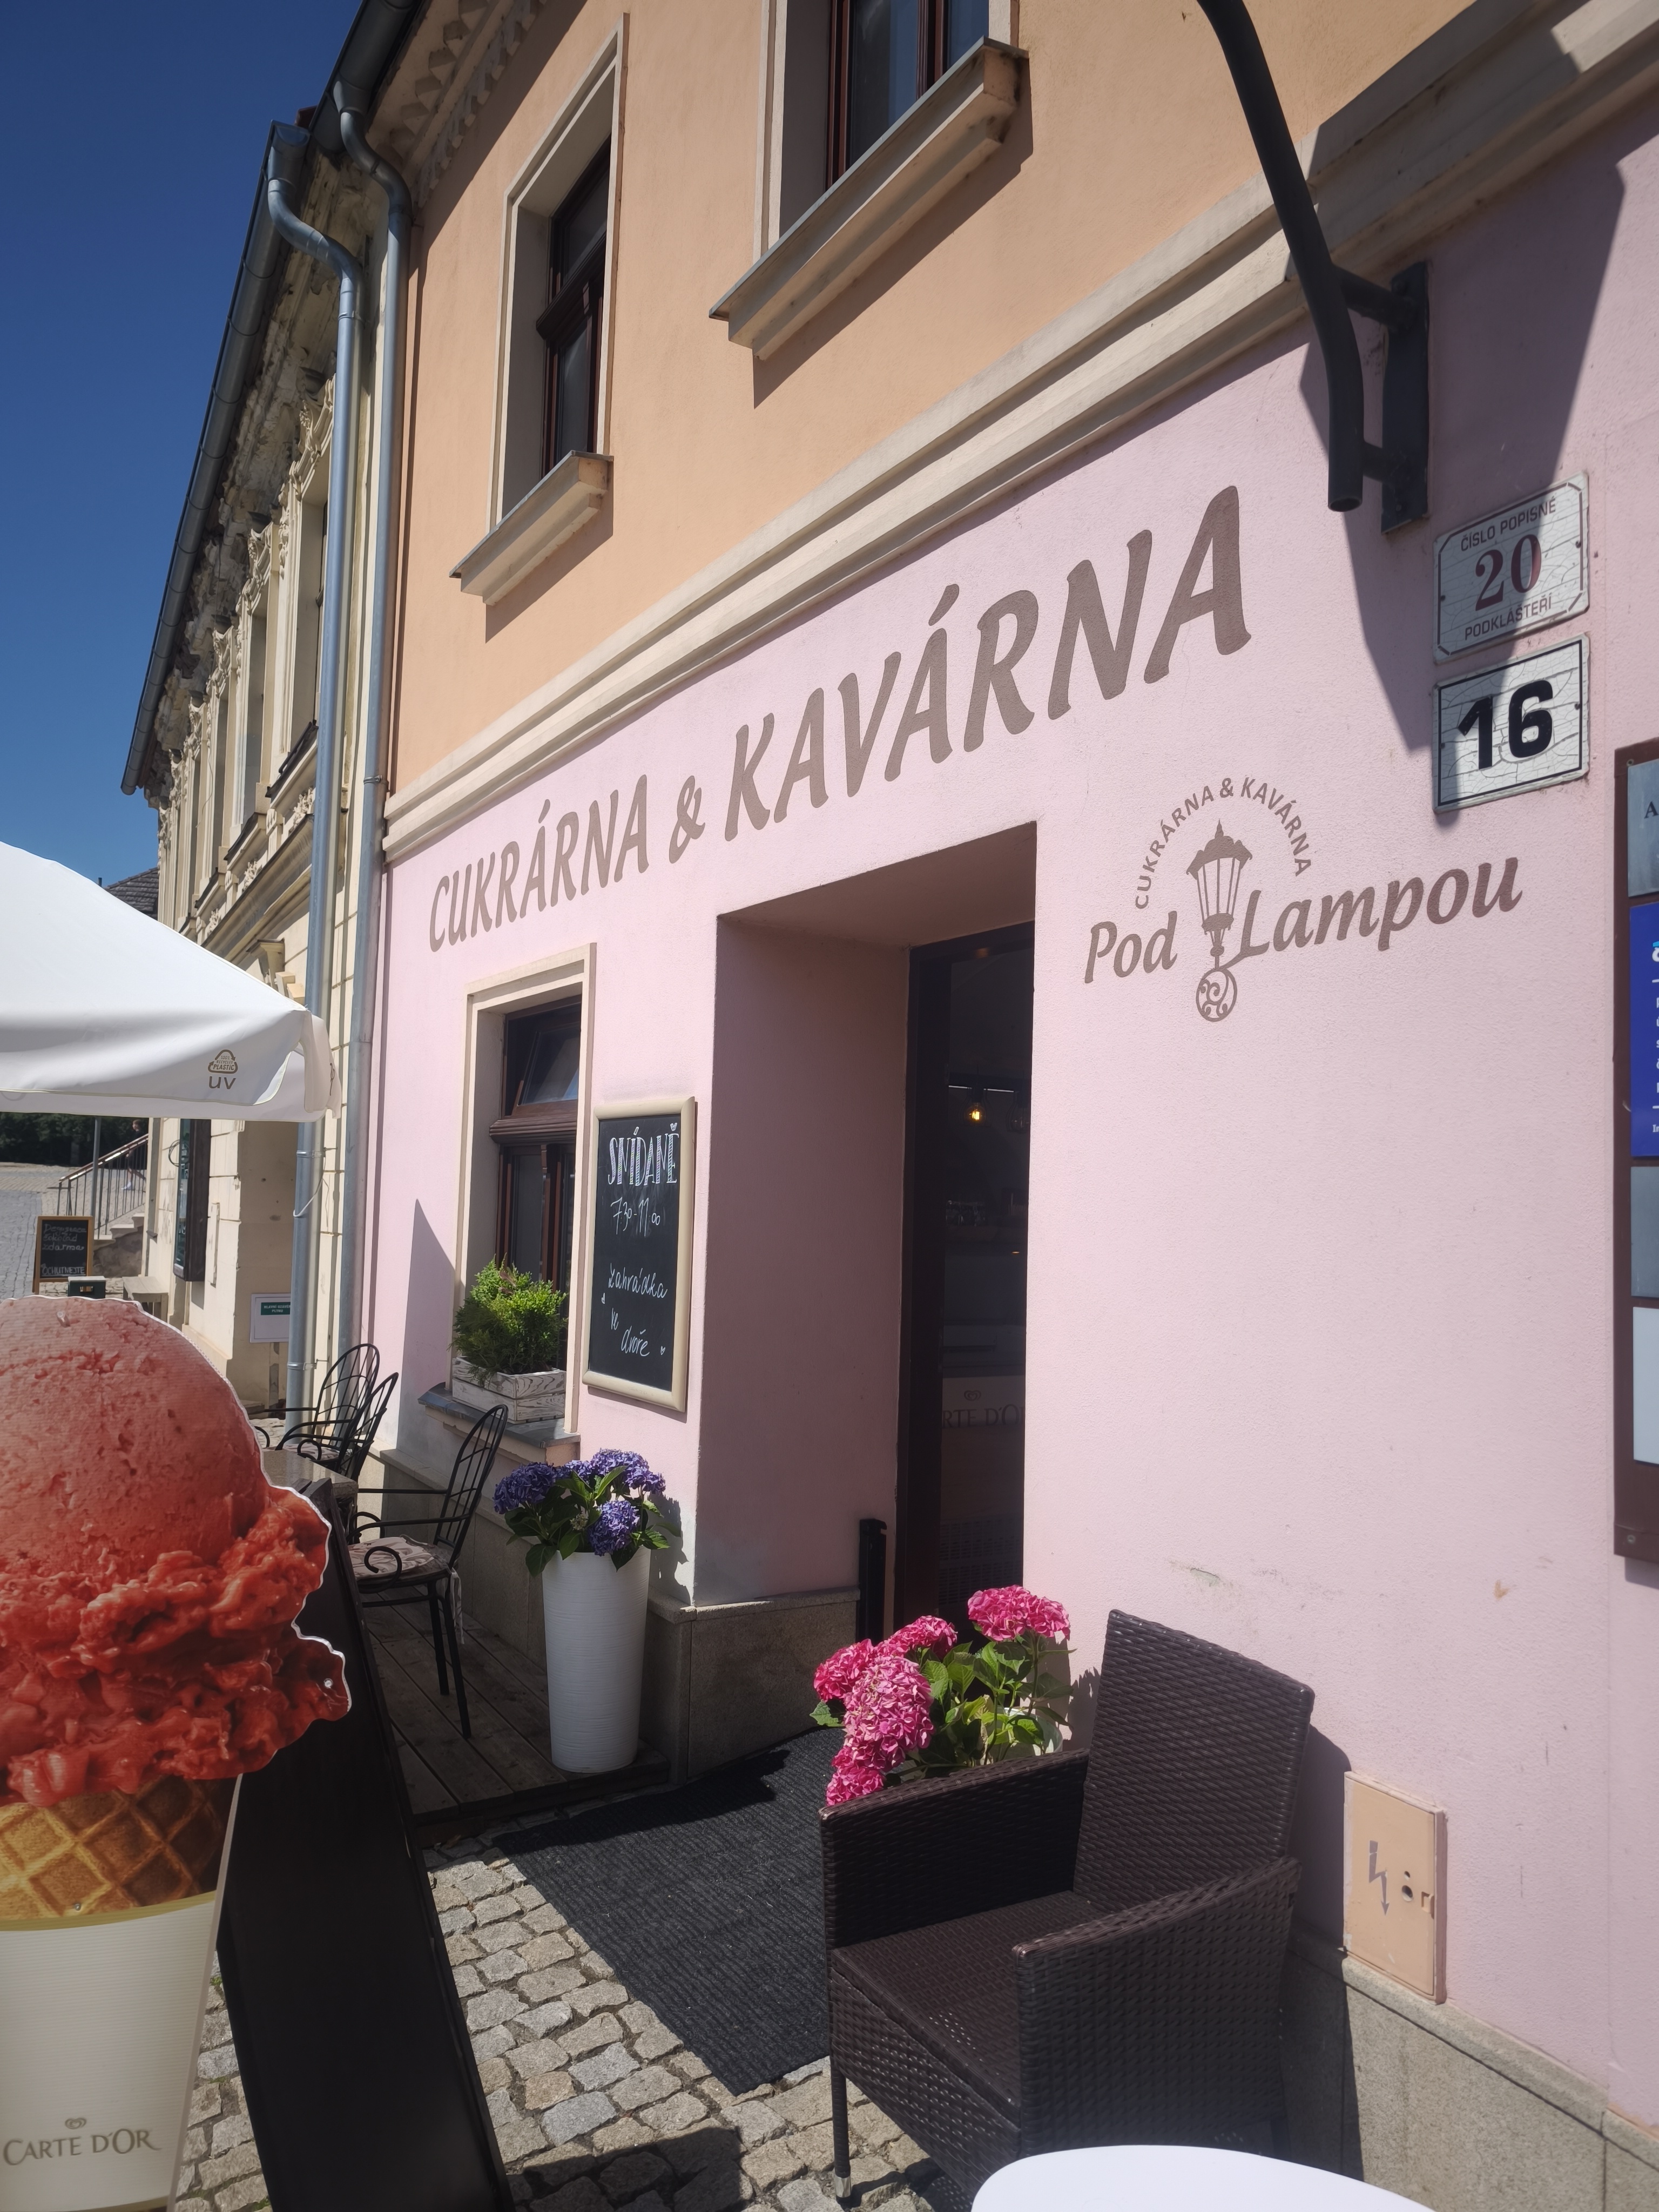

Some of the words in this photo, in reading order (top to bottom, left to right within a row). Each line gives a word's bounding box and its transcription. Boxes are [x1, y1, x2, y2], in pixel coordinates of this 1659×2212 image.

[1461, 524, 1495, 551] ČÍSLO
[1500, 495, 1556, 535] POPISNÉ
[1475, 534, 1542, 611] 20
[1465, 592, 1552, 640] PODKLÁŠTEŘÍ
[430, 774, 649, 952] CUKRÁRNA
[669, 775, 705, 864] &
[724, 485, 1251, 841] KAVÁRNA
[1458, 680, 1553, 770] 16
[1135, 785, 1215, 909] CUKRÁRNA
[1219, 777, 1234, 798] &
[1240, 777, 1312, 877] KAVÁRNA
[1084, 911, 1178, 984] Pod
[1237, 857, 1523, 952] Lampou
[608, 1122, 679, 1186] SNÍDANĚ
[942, 1408, 977, 1429] RTE
[3, 2136, 83, 2166] CARTE
[90, 2128, 164, 2155] D'OR
